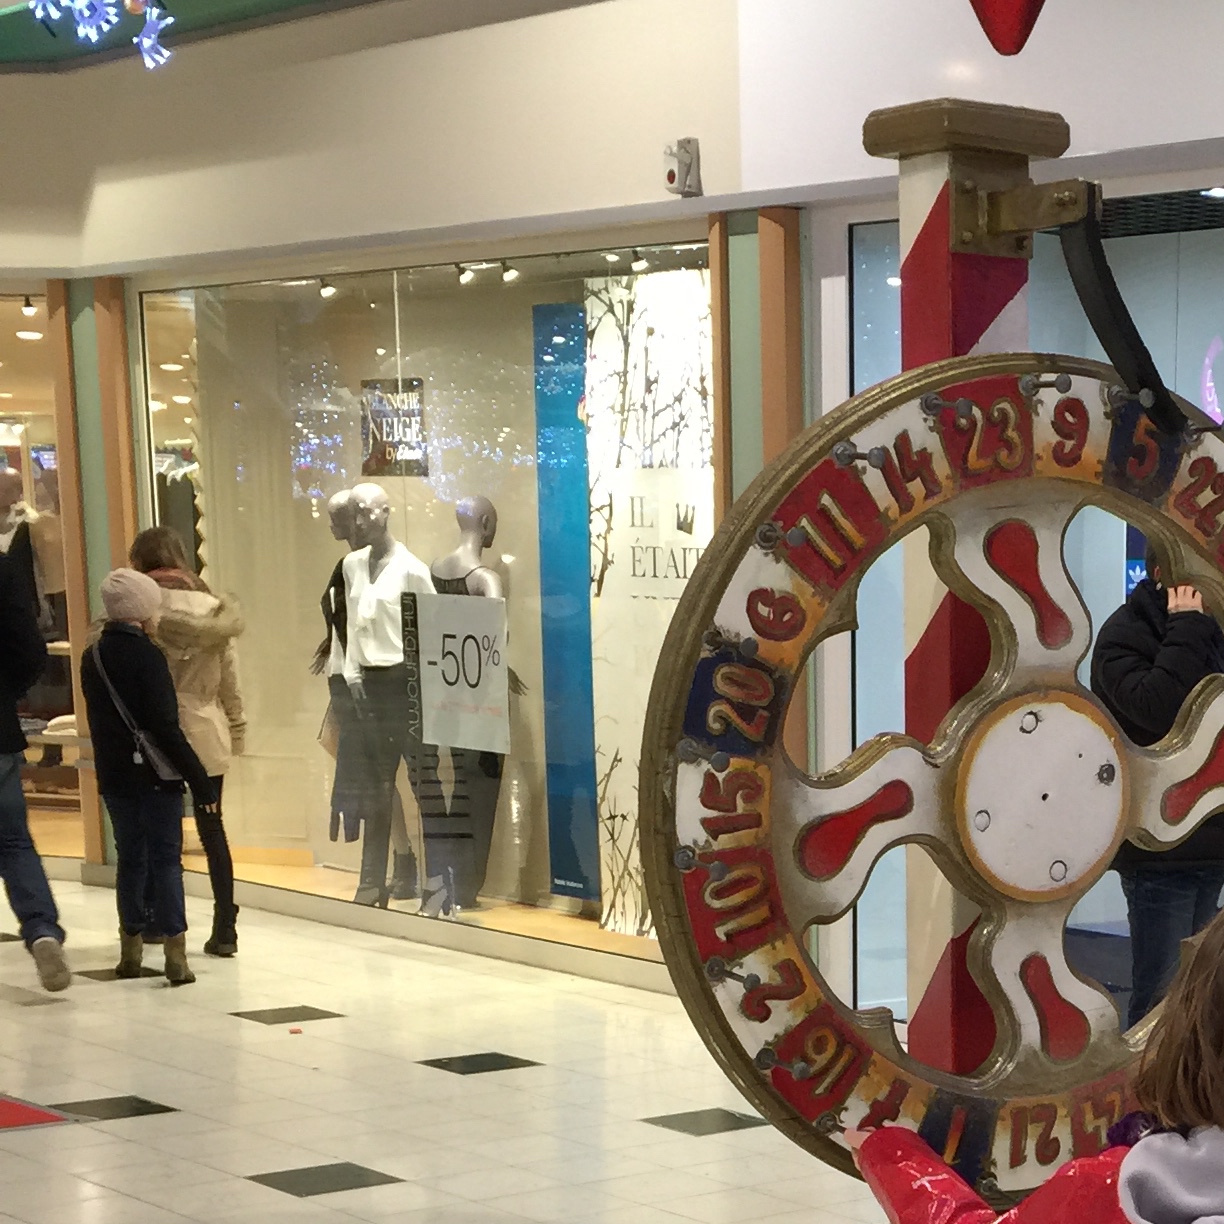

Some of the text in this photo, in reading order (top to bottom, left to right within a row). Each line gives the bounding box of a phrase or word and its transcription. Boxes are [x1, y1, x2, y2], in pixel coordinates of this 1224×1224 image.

[367, 416, 423, 454] NEIGE
[954, 396, 1025, 478] 23
[1051, 396, 1090, 468] 9
[1126, 414, 1161, 482] 5
[880, 428, 943, 515] 14
[630, 495, 654, 528] IL
[796, 487, 867, 574] 11
[630, 537, 706, 579] ÉTAIT
[402, 594, 421, 741] AUJOURD'HUI
[427, 633, 501, 689] -50%
[706, 662, 775, 743] 20
[699, 767, 765, 842] 15
[703, 862, 774, 943] 10
[741, 957, 808, 1023] 2
[803, 1024, 862, 1098] 16
[1008, 1101, 1062, 1169] 21
